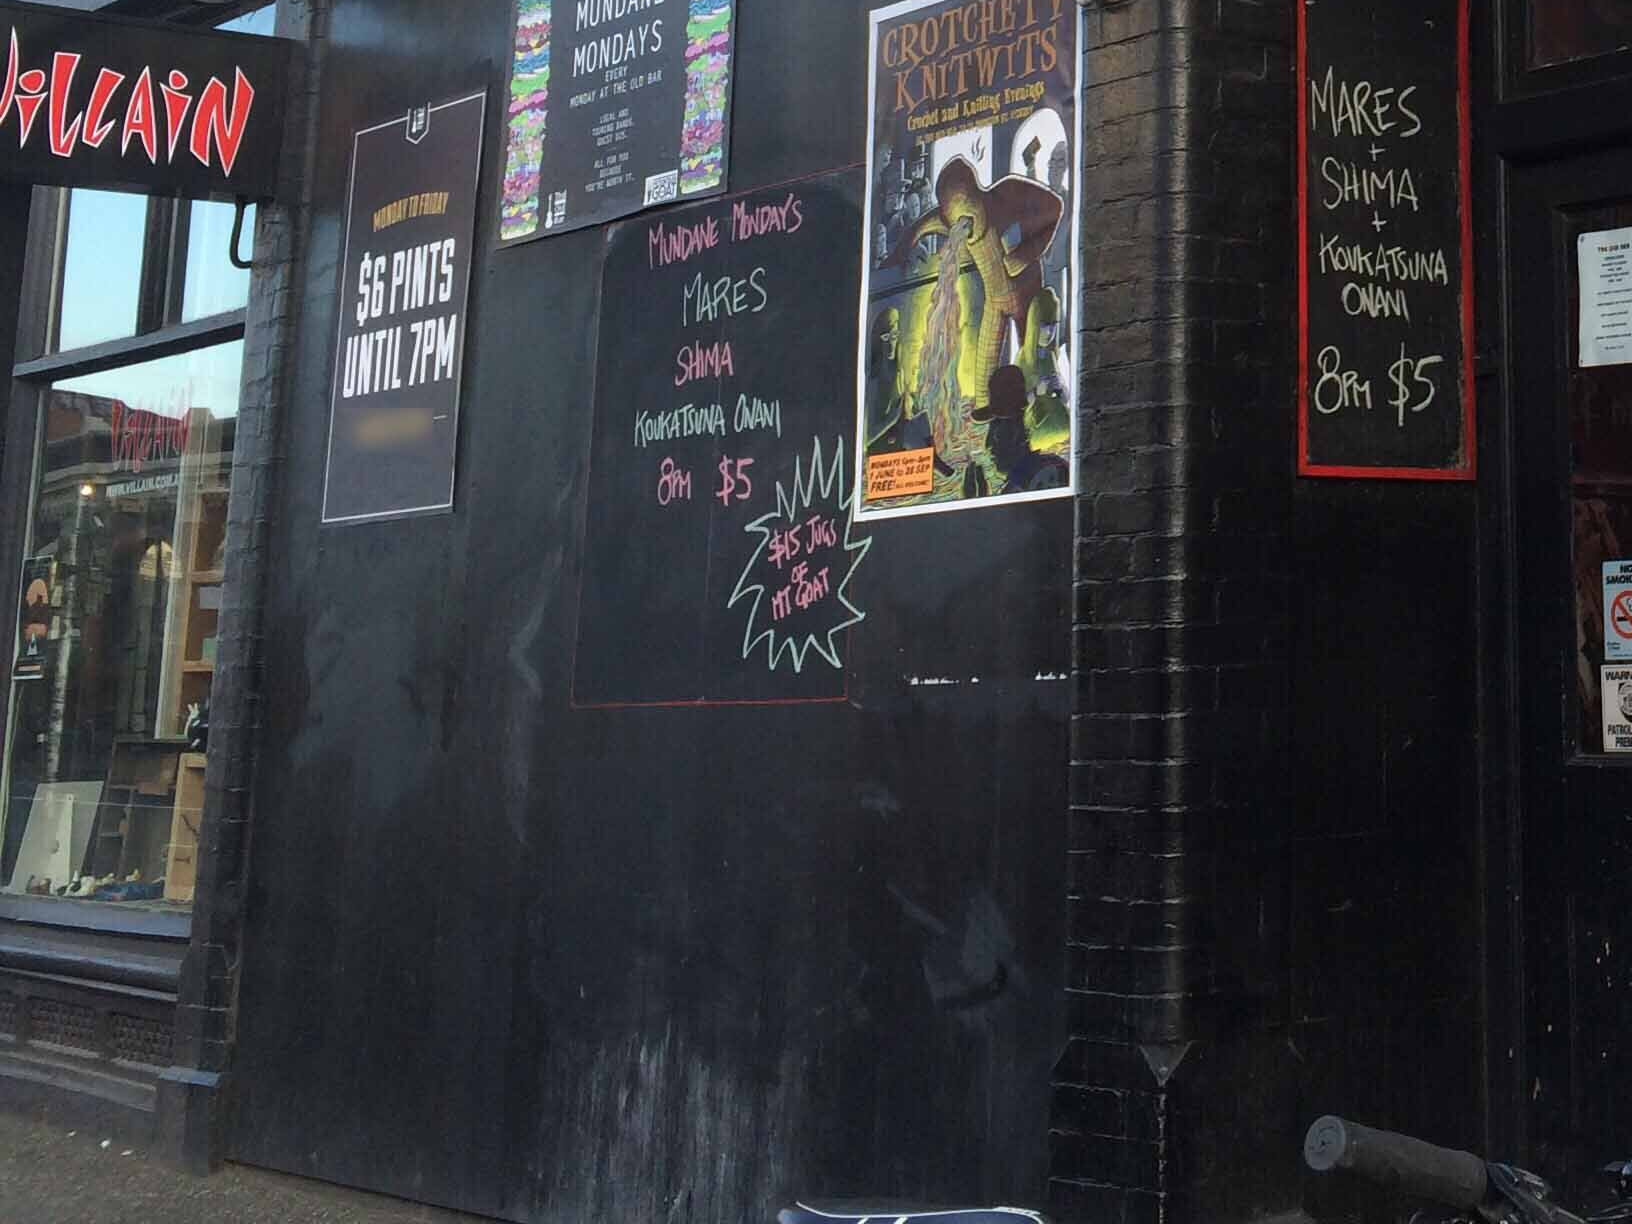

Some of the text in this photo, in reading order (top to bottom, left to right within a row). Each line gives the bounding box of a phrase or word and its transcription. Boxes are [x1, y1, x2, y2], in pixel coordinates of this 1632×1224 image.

[573, 20, 664, 78] MONDAYS
[893, 23, 1057, 114] KNITWITS
[1311, 65, 1421, 138] MARES
[1321, 157, 1419, 212] SHIMA
[648, 216, 719, 271] MUNDANE
[356, 237, 456, 328] $6 PINTS
[682, 266, 768, 329] MARES
[1341, 282, 1410, 322] ONANI
[341, 314, 458, 399] UNTIL 7PM
[674, 341, 735, 387] SHIMA
[1388, 341, 1444, 427] $5
[734, 392, 782, 439] ONANI
[716, 454, 755, 508] $5
[768, 532, 801, 570] $15
[794, 568, 830, 609] GOAT
